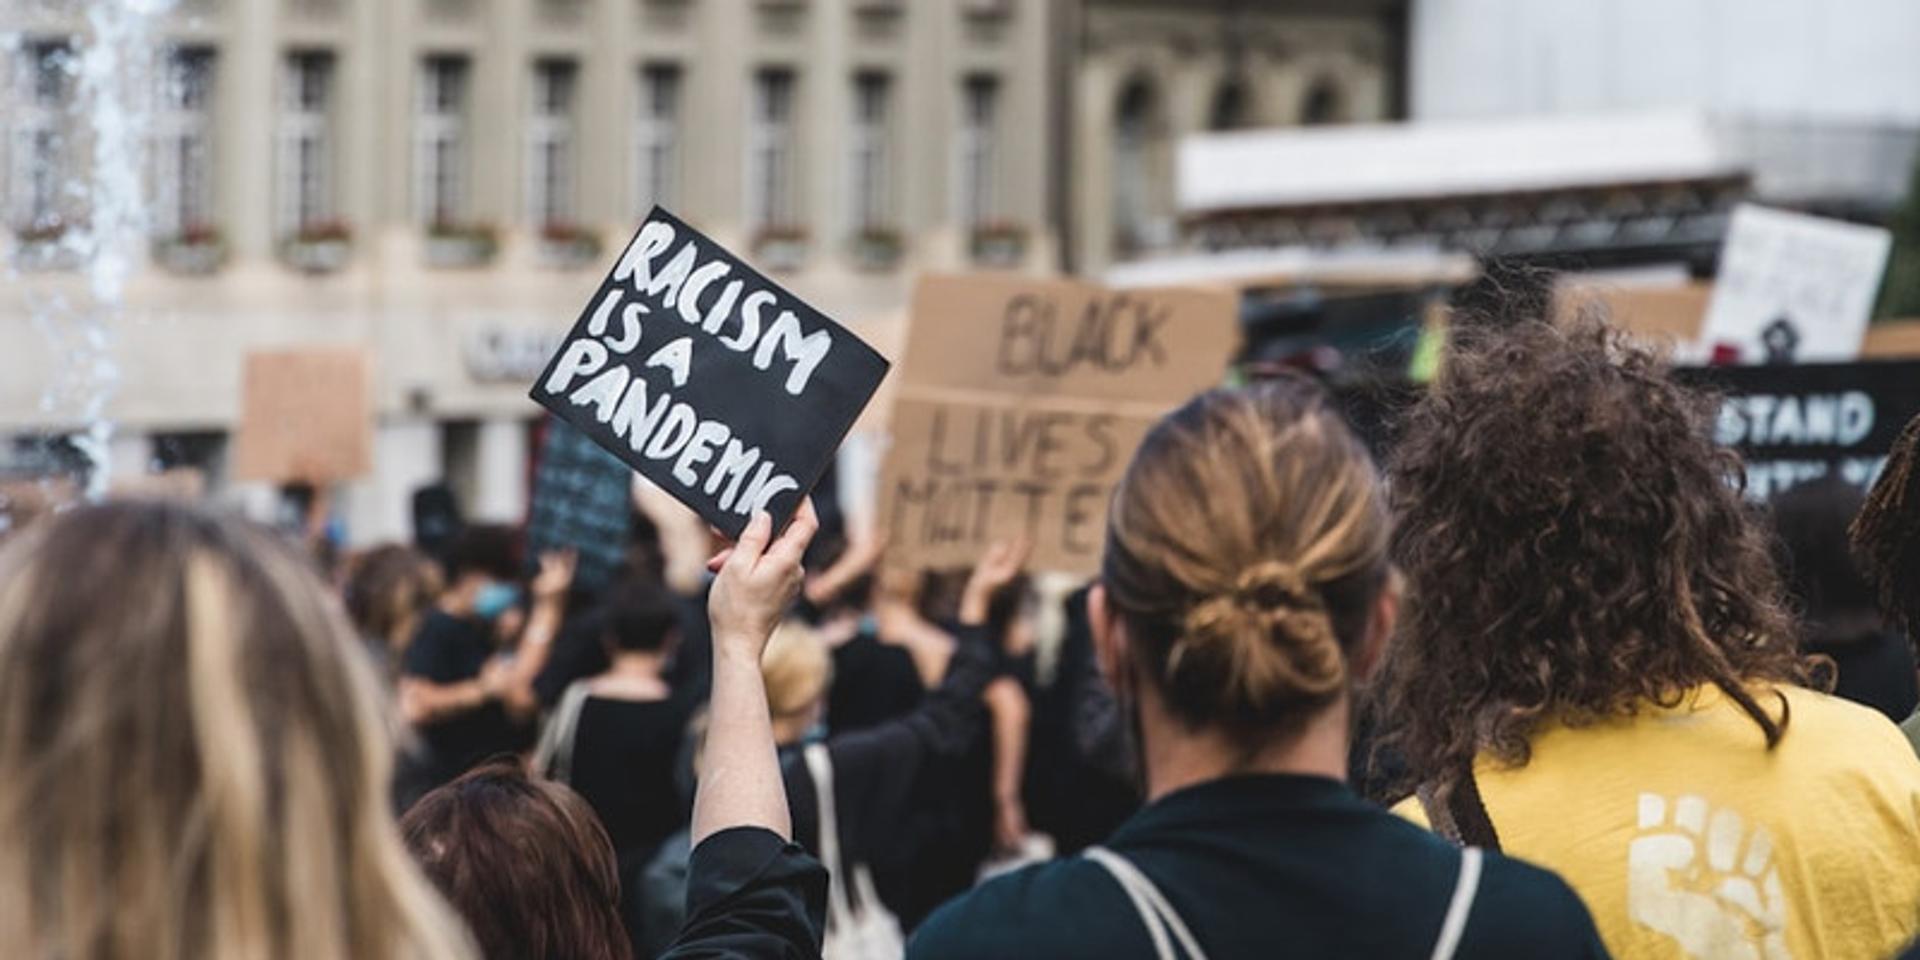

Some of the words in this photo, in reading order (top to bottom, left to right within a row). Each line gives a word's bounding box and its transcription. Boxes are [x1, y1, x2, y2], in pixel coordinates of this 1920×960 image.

[588, 289, 650, 355] IS
[645, 337, 694, 388] A
[613, 221, 832, 395] RACISM
[997, 294, 1173, 378] BLACK
[544, 338, 799, 516] PANDEMIC
[927, 408, 1121, 479] LIVES
[1712, 391, 1876, 446] STAND
[888, 478, 1103, 554] MATTE
